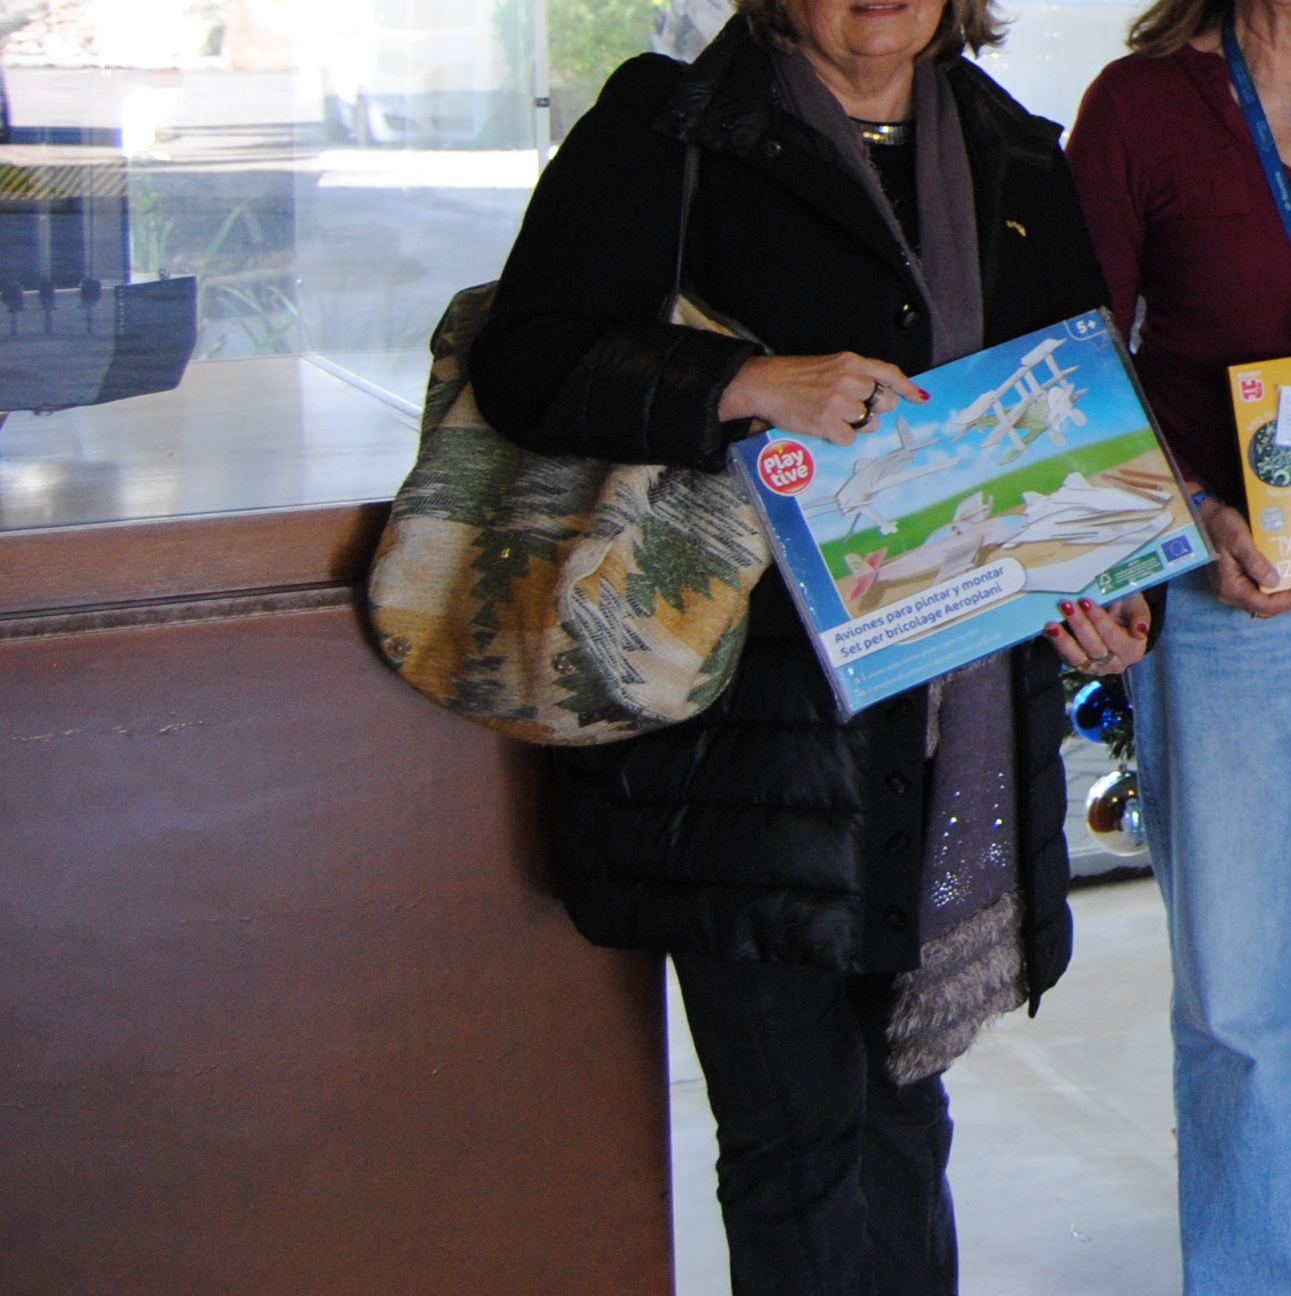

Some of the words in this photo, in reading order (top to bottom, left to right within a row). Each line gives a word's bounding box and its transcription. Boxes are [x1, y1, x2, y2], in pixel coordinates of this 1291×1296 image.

[1076, 319, 1097, 334] 5+
[763, 449, 804, 474] Play
[770, 464, 809, 487] tive
[835, 618, 885, 644] Aviones
[887, 605, 914, 625] para
[914, 588, 951, 612] pintar
[952, 585, 960, 597] y
[962, 566, 1004, 591] montar
[840, 643, 863, 658] Set
[863, 635, 885, 651] per
[884, 608, 943, 639] bricolage
[944, 582, 1004, 614] Aeroplani
